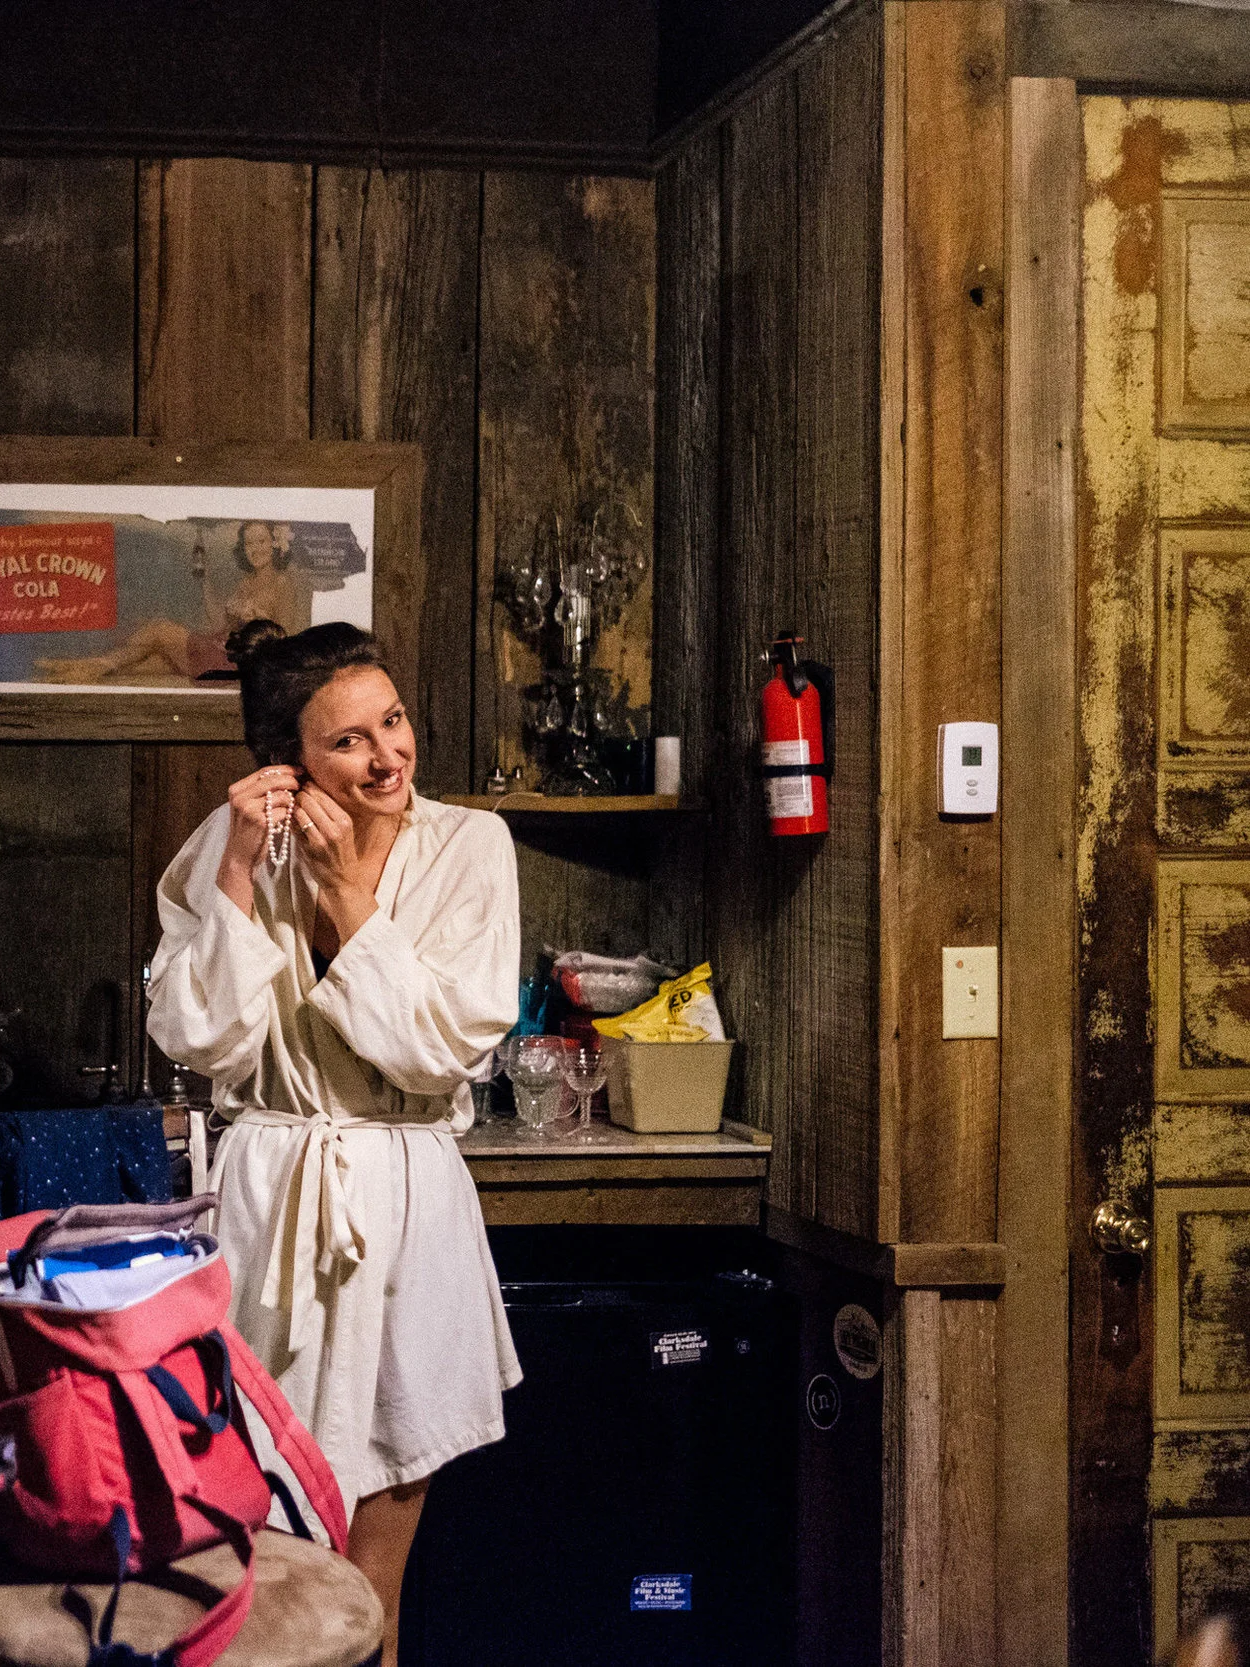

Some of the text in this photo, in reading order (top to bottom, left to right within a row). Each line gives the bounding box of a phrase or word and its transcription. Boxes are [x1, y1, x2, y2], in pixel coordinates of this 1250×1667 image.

[36, 553, 107, 586] CROWN
[12, 580, 60, 598] COLA
[653, 1340, 708, 1354] Film Festival
[658, 1334, 702, 1346] Clarksdale
[634, 1587, 653, 1595] Film
[654, 1587, 662, 1595] &
